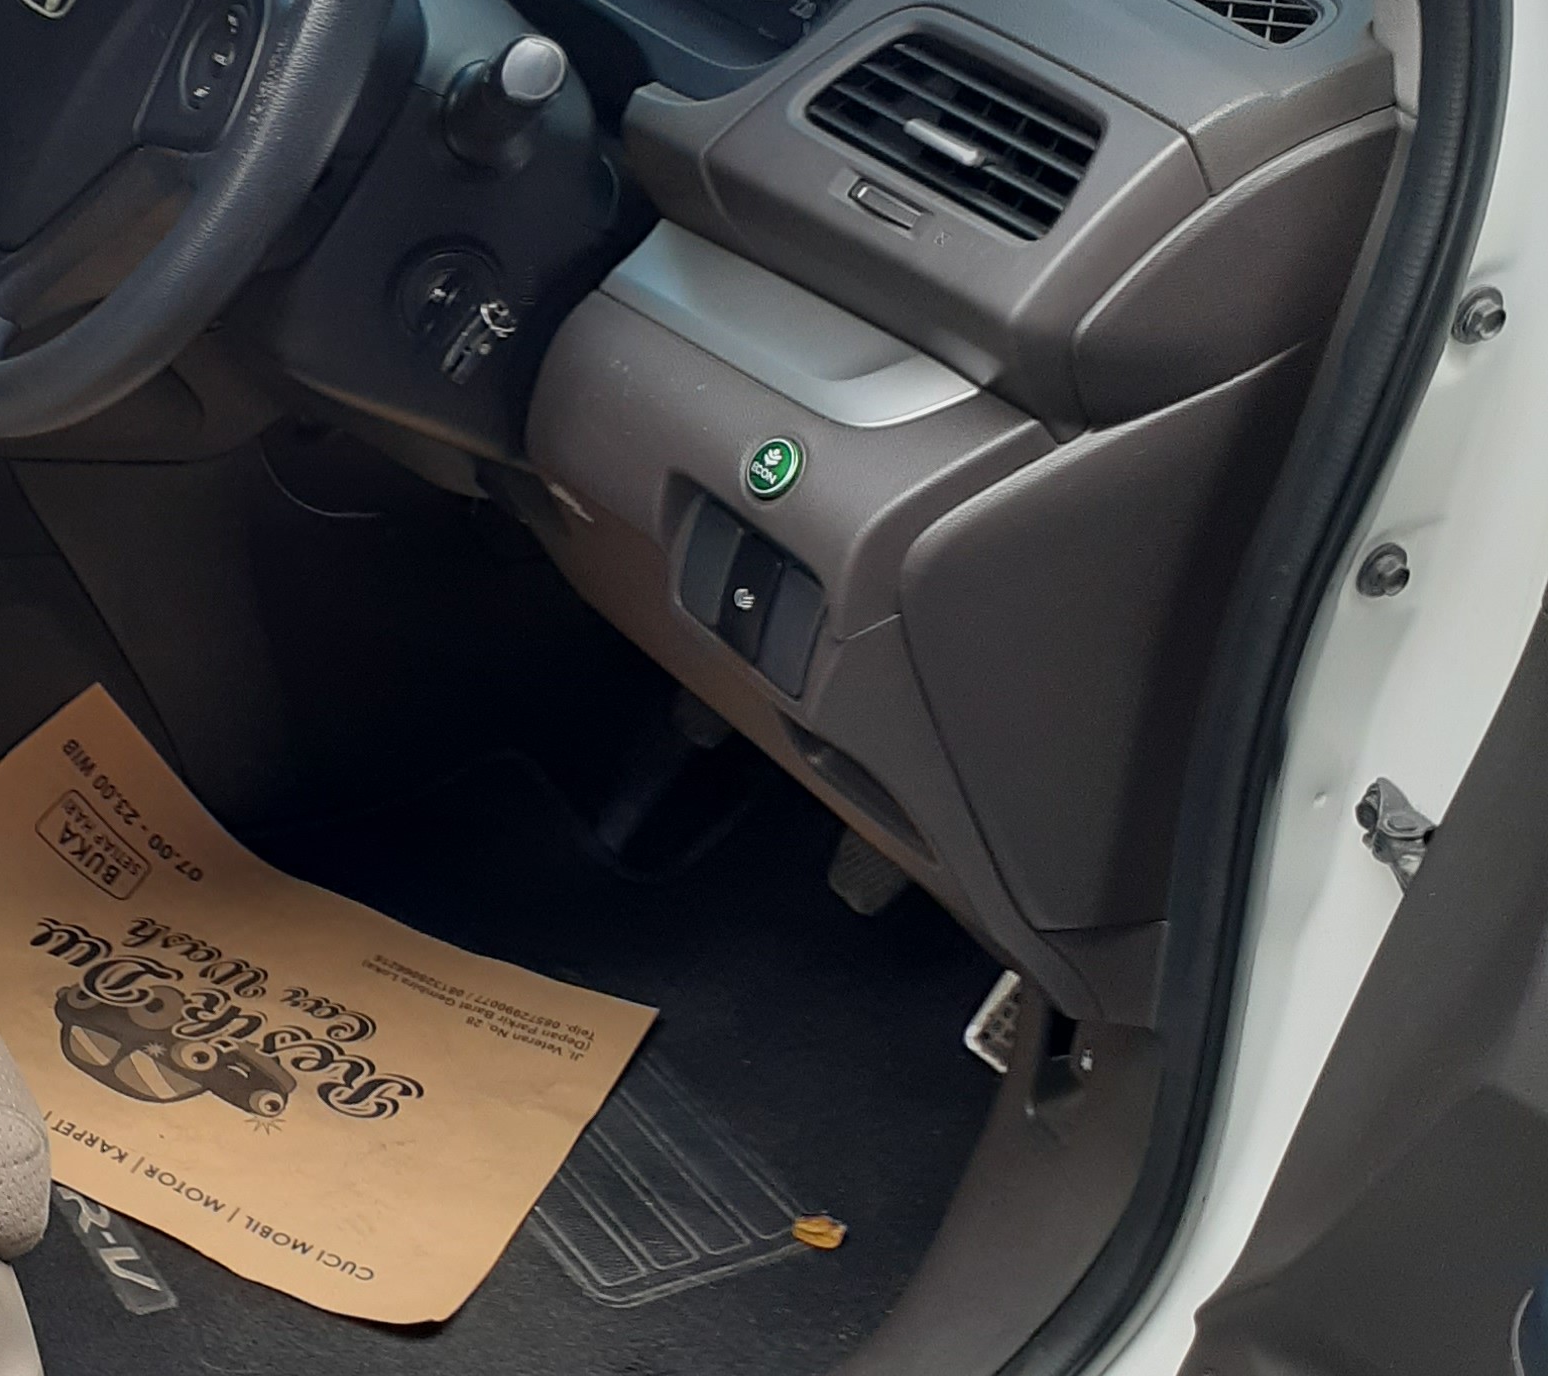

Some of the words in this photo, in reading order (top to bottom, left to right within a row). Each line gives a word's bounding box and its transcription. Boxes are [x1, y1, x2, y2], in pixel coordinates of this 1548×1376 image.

[751, 460, 777, 485] ECON
[63, 739, 97, 776] WIB
[93, 775, 141, 825] 23.00
[58, 821, 121, 886] BUKA
[94, 834, 141, 875] SETIAP
[148, 834, 203, 882] 07.00
[122, 917, 268, 998] Wash
[280, 986, 377, 1043] Car
[497, 1015, 539, 1035] Parkir
[172, 988, 425, 1119] Resik
[512, 1034, 563, 1056] Veteran
[51, 1119, 129, 1164] KARPET
[144, 1164, 226, 1212] MOTOR
[56, 1185, 162, 1291] R-V
[245, 1215, 314, 1255] MOBIL
[316, 1250, 374, 1281] CUCI
